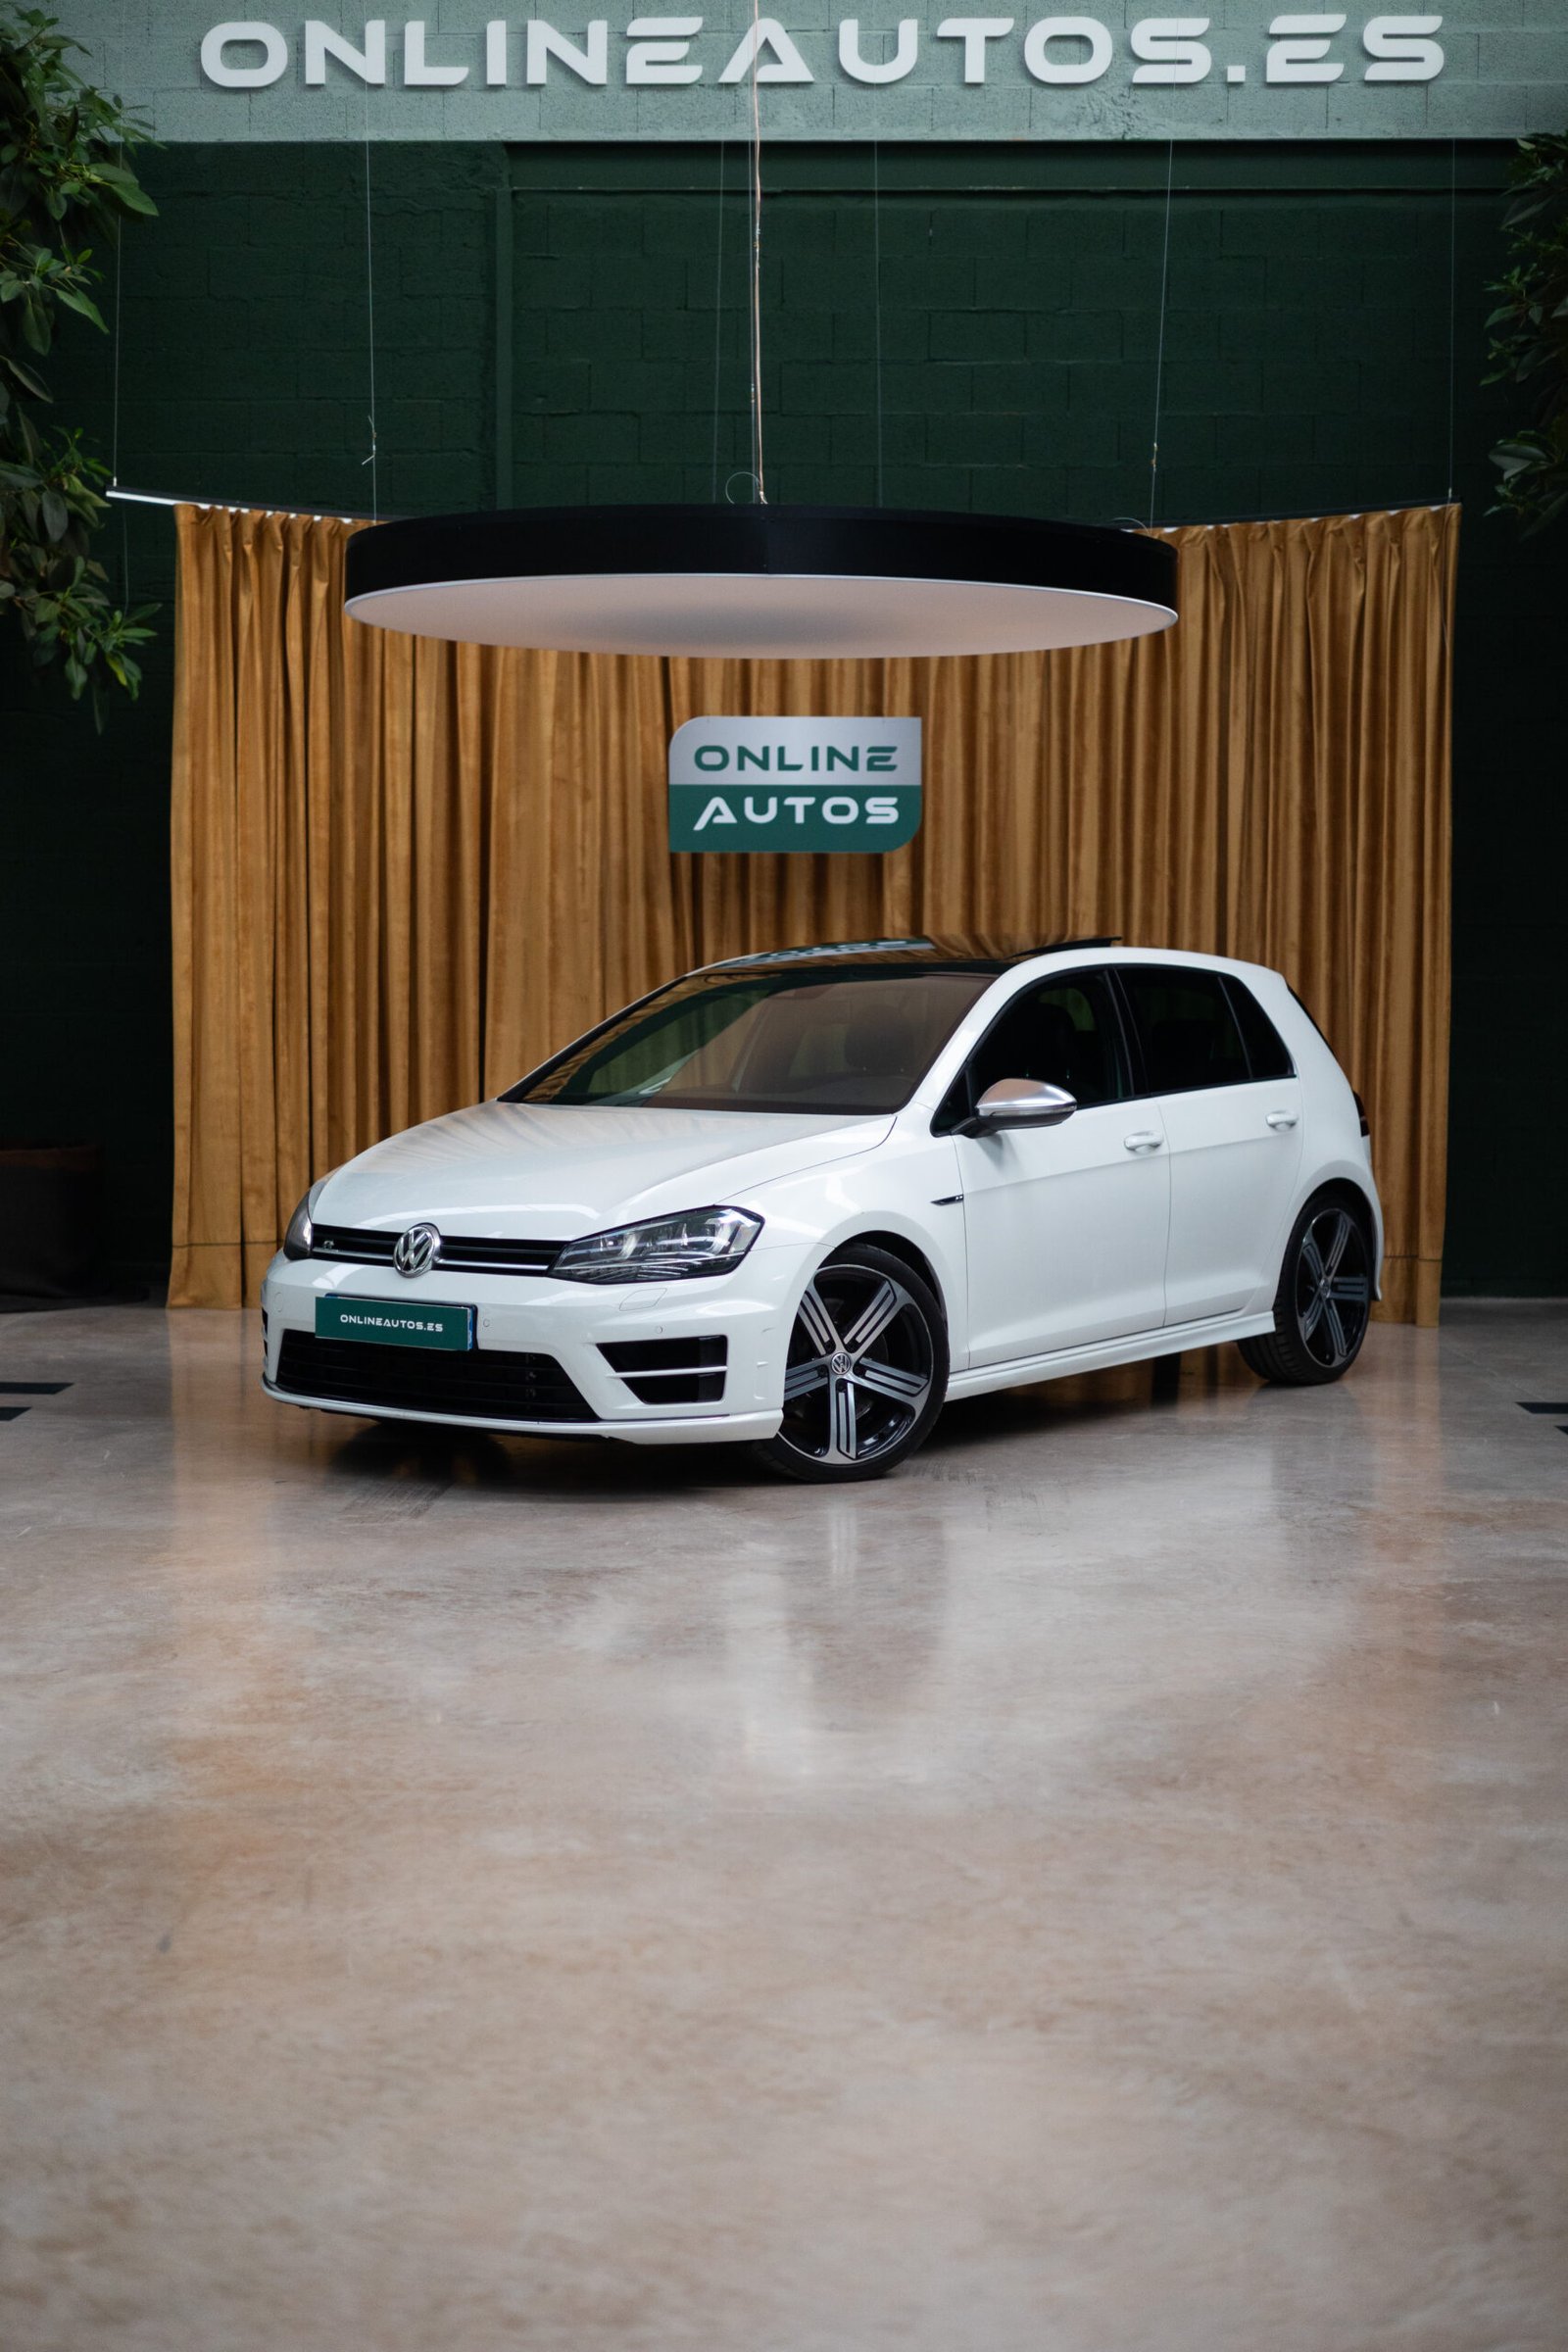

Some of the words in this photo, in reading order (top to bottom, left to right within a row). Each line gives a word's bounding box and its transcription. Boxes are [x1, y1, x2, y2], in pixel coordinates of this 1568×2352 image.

[200, 14, 1446, 88] ONLINEAUTOS.ES
[694, 745, 898, 771] ONLINE
[693, 796, 899, 831] AUTOS
[340, 1314, 444, 1332] ONLINEAUTOS.ES
